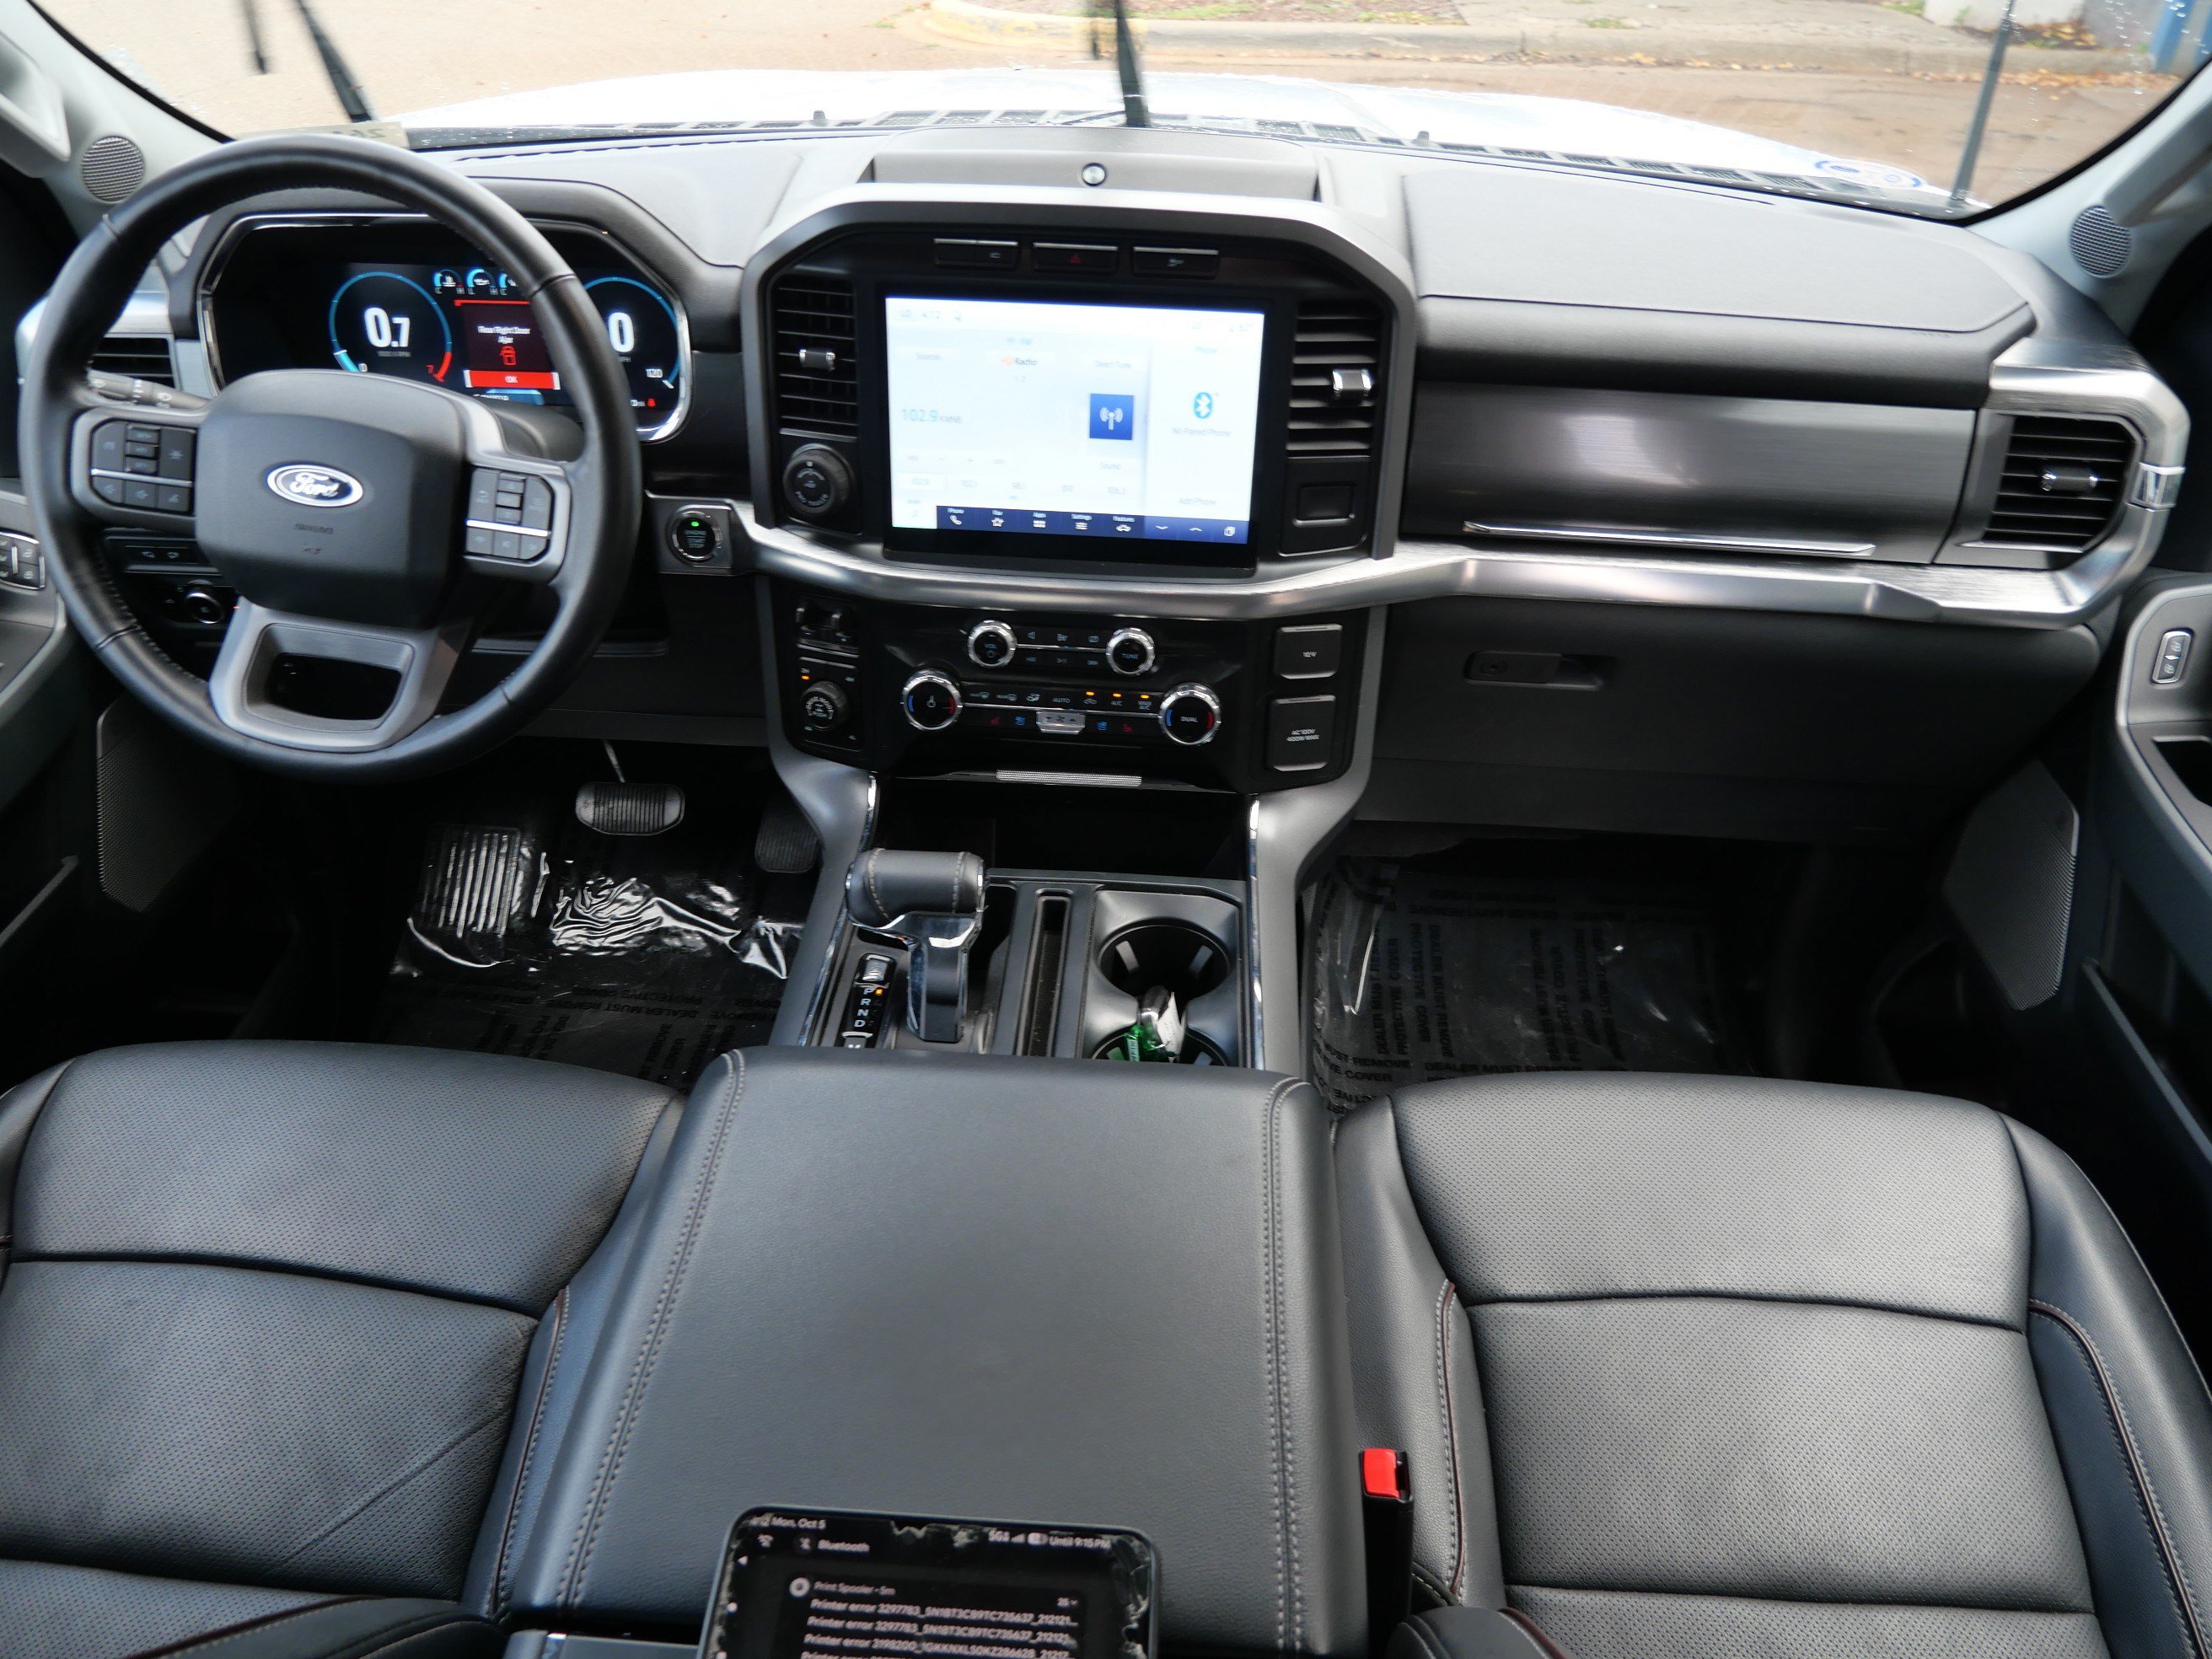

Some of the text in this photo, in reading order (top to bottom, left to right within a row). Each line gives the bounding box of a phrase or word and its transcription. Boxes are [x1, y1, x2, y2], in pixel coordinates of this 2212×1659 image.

[364, 307, 411, 348] 0.7
[608, 311, 635, 352] 0
[1014, 356, 1038, 366] Radio
[289, 471, 341, 498] Ford
[1387, 938, 1401, 980] COVER
[854, 1019, 867, 1028] D
[1352, 1055, 1411, 1069] REMOVE
[1425, 1061, 1479, 1073] DEALER
[1345, 1064, 1393, 1082] COVER
[810, 1598, 848, 1611] Printer
[848, 1603, 877, 1613] error
[807, 1616, 846, 1629] Printer
[846, 1620, 874, 1630] error
[803, 1633, 843, 1646] Printer
[842, 1637, 872, 1648] error
